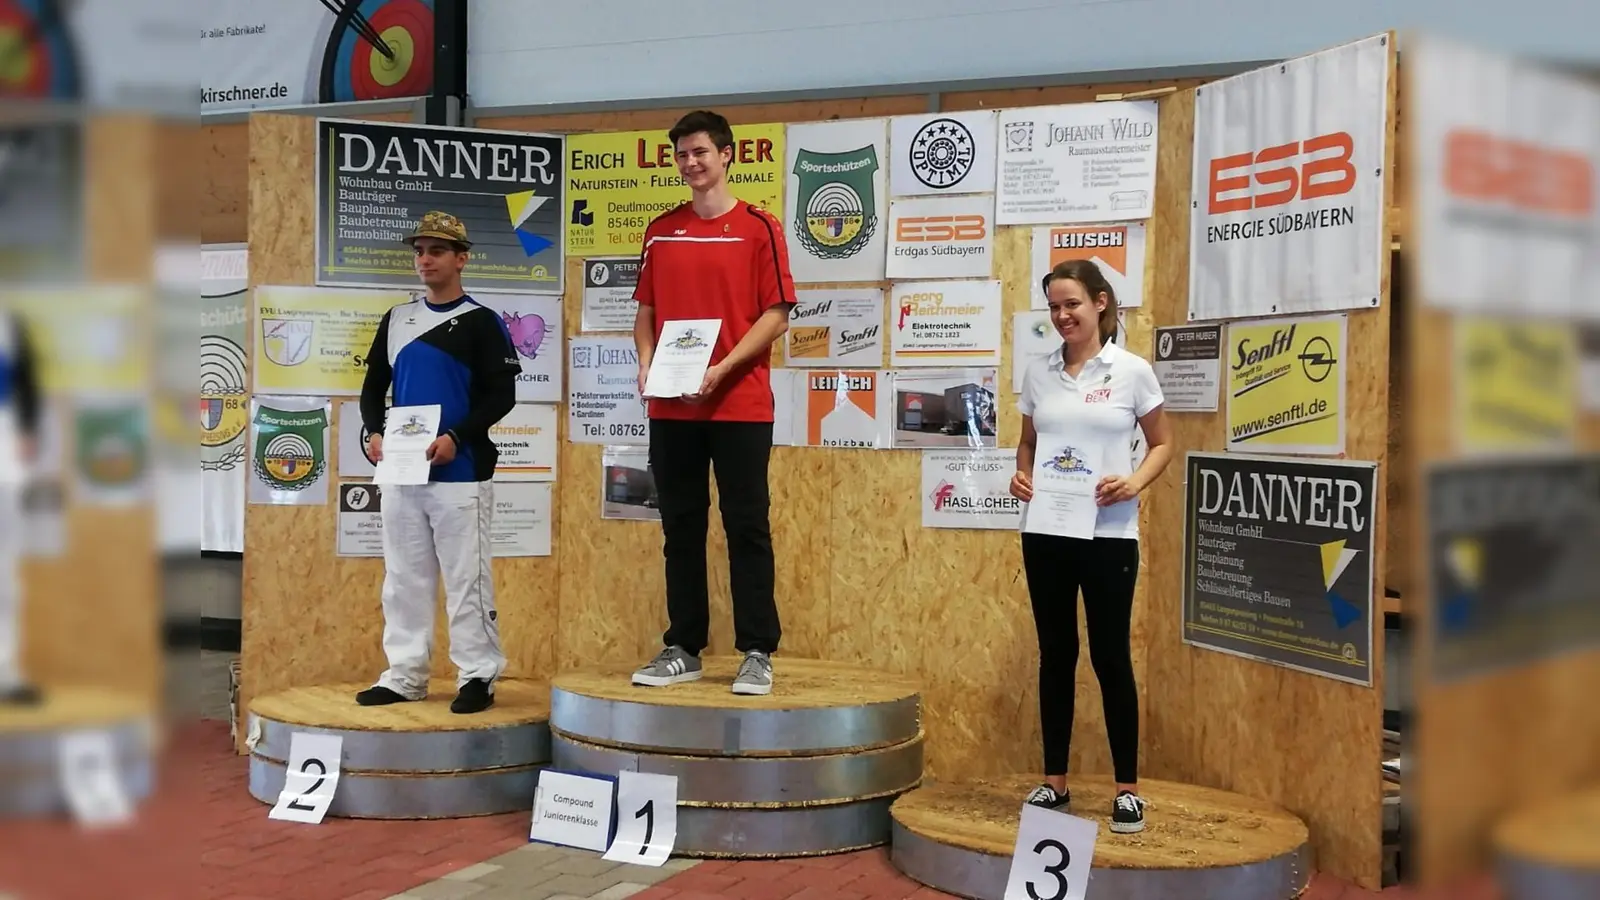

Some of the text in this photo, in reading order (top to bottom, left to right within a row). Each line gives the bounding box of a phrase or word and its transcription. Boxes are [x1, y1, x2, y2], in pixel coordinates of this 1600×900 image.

[209, 29, 225, 39] alle
[201, 83, 288, 104] kirschner.de
[1045, 118, 1153, 148] JOHANN WILD
[339, 132, 556, 186] DANNER
[571, 137, 774, 171] ERICH LEER
[800, 157, 871, 174] Sportschützen
[914, 147, 971, 184] OPTIMAL
[1208, 131, 1357, 216] ESB
[339, 176, 433, 192] Wohnbau GmbH
[570, 172, 774, 191] NATURSTEIN FLIESE ABMALE
[339, 189, 398, 204] Bauträger
[339, 202, 408, 217] Bauplanung
[608, 201, 676, 213] Deutlmooser
[339, 214, 420, 231] Baubetreuung
[608, 217, 644, 229] 85465
[896, 215, 985, 242] ESB
[1208, 205, 1354, 244] ENERGIE SÜDBAYERN
[339, 227, 405, 242] Immobilien
[570, 229, 595, 237] NATUR
[608, 232, 625, 244] Tel.
[1053, 232, 1124, 249] LEITSCH
[570, 238, 595, 246] STEIN
[895, 244, 985, 259] Erdgas Südbayern
[613, 262, 638, 272] PETER
[912, 322, 972, 331] Elektrotechnik
[1195, 330, 1218, 340] HUBER
[1232, 323, 1297, 371] Senftl
[516, 374, 550, 383] ACHER
[225, 399, 238, 409] 68
[260, 413, 322, 427] Sportschützen
[576, 411, 605, 420] Gardinen
[1232, 398, 1328, 438] www.senftl.de
[582, 423, 646, 437] Tel: 08762
[496, 441, 530, 449] otechnik
[823, 438, 873, 448] holzbau
[943, 497, 1020, 509] HASLACHER
[1198, 468, 1365, 533] DANNER
[1198, 518, 1263, 539] Wohnbau GmbH
[1197, 533, 1237, 553] Bauträger
[1197, 548, 1245, 571] Bauplanung
[1196, 564, 1253, 587] Baubetreuung
[1195, 579, 1291, 609] Schlüsselfertiges Bauen
[286, 758, 327, 812] 2
[553, 792, 594, 809] Compound
[543, 810, 599, 828] Juniorenklasse
[635, 799, 654, 856] 1
[1025, 838, 1071, 900] 3
